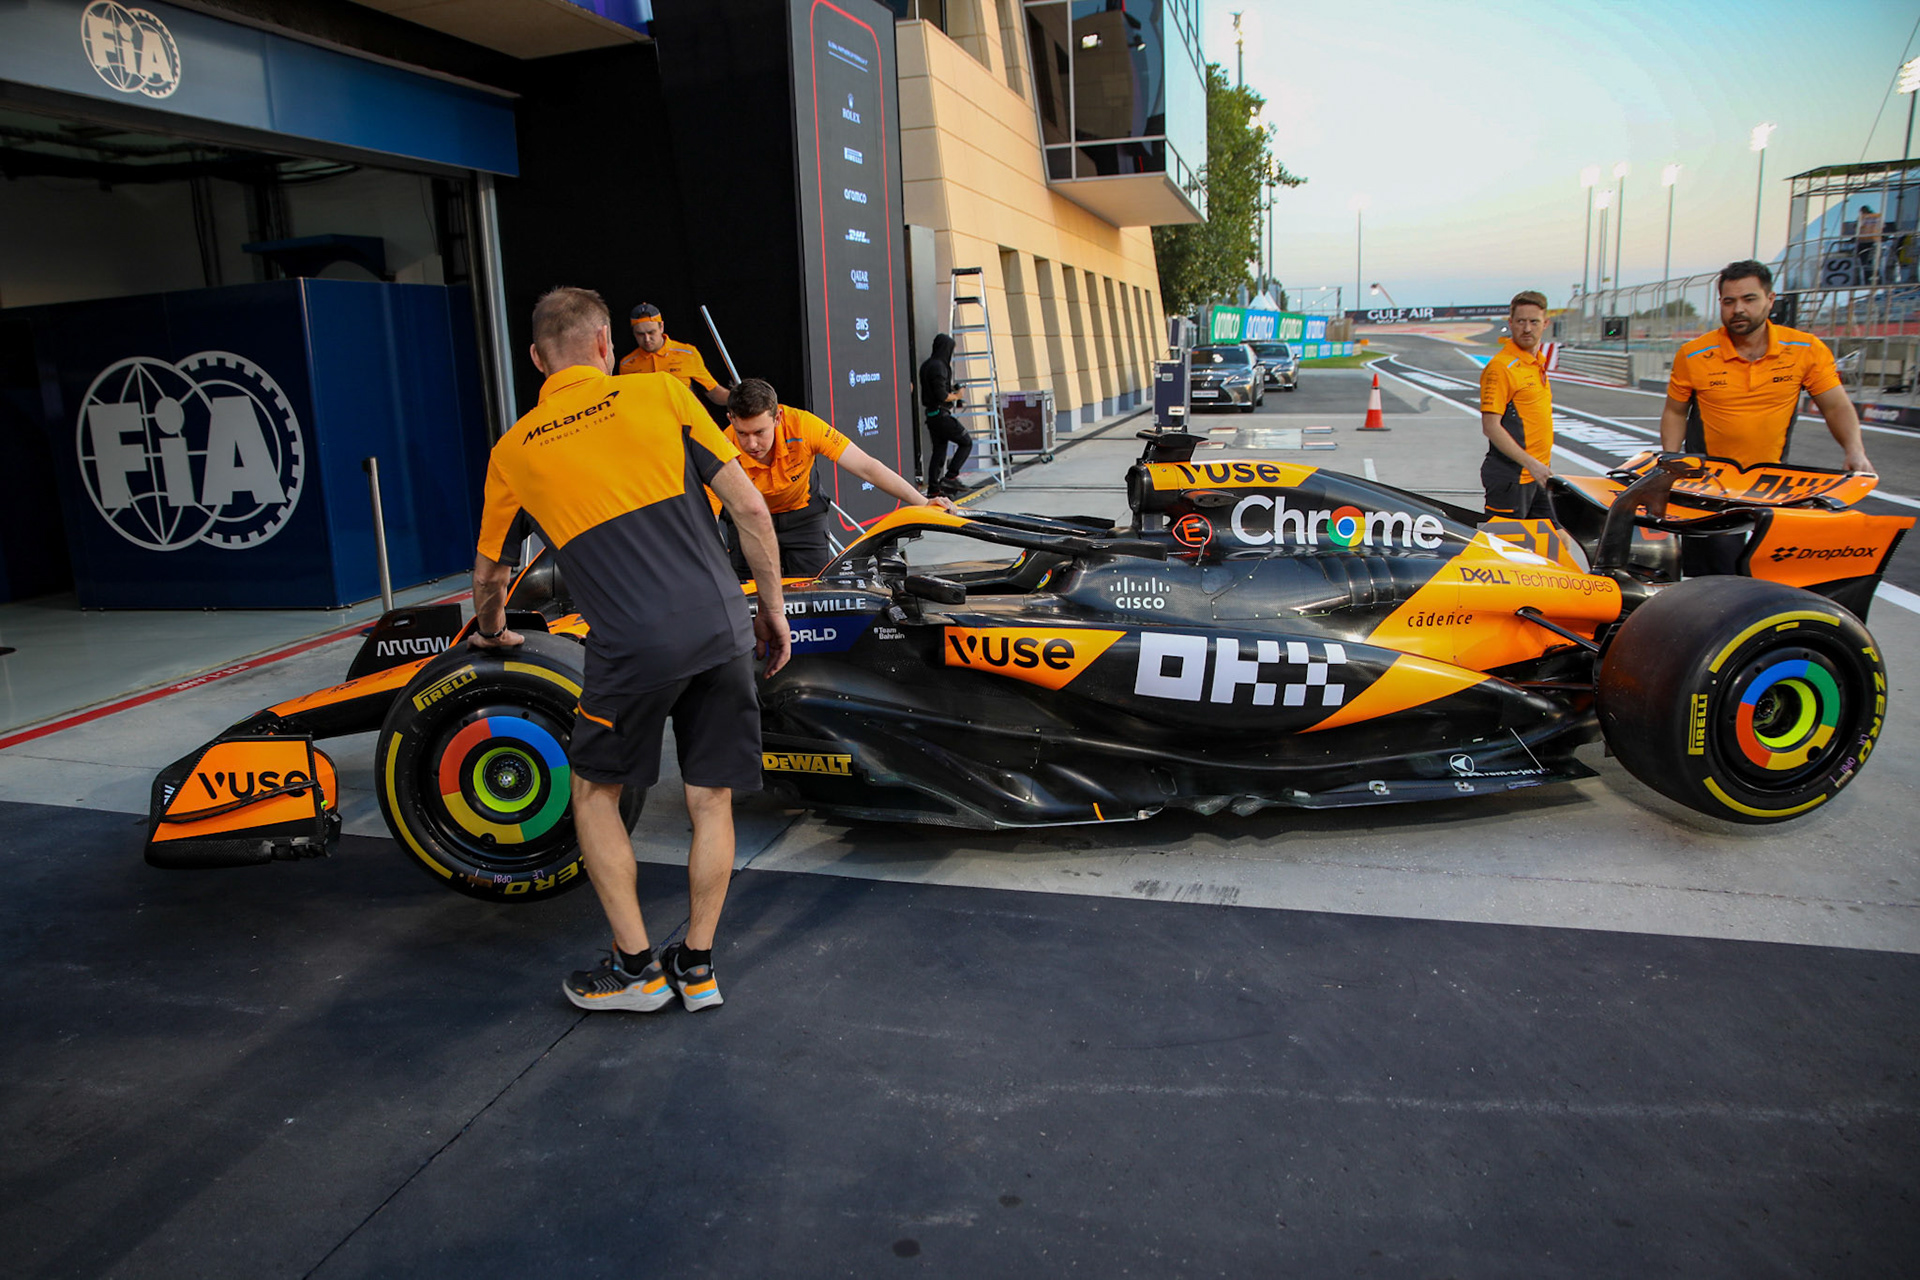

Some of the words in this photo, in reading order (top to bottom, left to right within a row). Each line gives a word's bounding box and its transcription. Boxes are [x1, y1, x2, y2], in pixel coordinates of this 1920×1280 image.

[842, 107, 861, 124] ROLEX
[844, 188, 867, 204] aramco
[847, 228, 867, 243] DHL
[850, 269, 869, 283] QATAR
[1826, 260, 1851, 285] SC
[1367, 308, 1406, 320] GULF
[1408, 306, 1434, 319] AIR
[1214, 312, 1240, 340] aramco
[1246, 315, 1274, 340] aramco
[1279, 317, 1303, 339] aramco
[856, 372, 880, 383] crypto.com
[522, 399, 612, 446] McLaren
[540, 428, 580, 447] FORMULA
[594, 412, 616, 425] TEAM
[864, 415, 879, 430] MSC
[1231, 495, 1444, 549] Chrome
[1799, 545, 1878, 562] Dropbox
[1460, 567, 1510, 585] DELL
[1510, 570, 1613, 595] Technologies
[813, 598, 866, 613] MILLE
[1115, 596, 1165, 609] cisco
[790, 628, 837, 643] ORLD
[1862, 647, 1879, 662] P
[1134, 631, 1347, 706] OKX
[412, 664, 478, 712] PIRELLI
[1688, 693, 1708, 755] PIRELLI
[1858, 671, 1886, 764] ZERO
